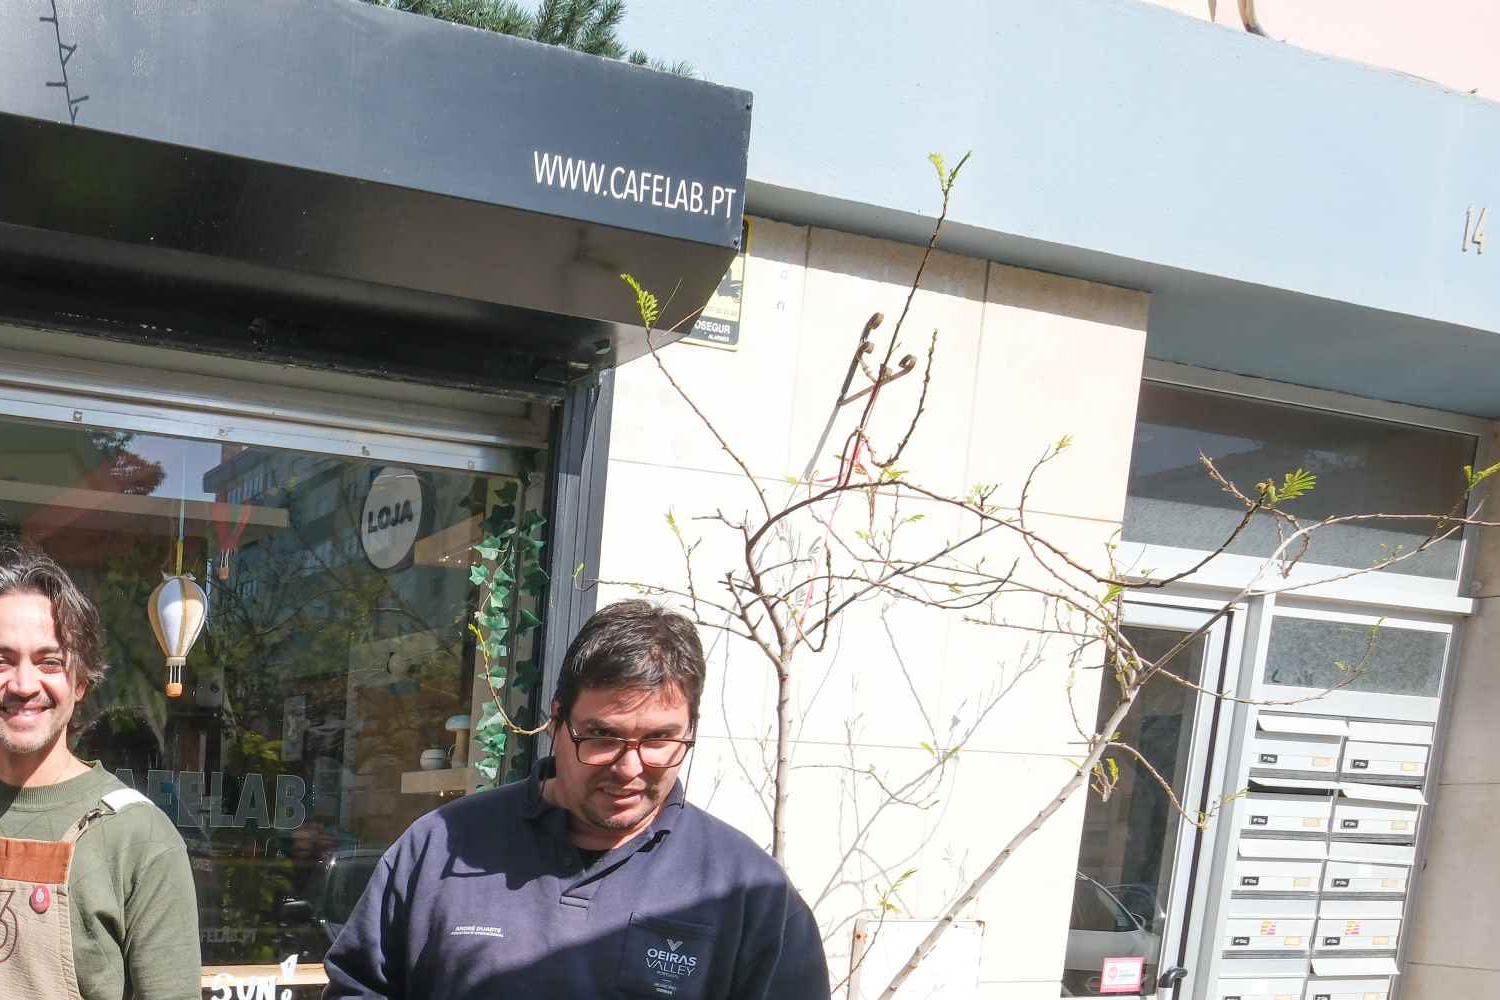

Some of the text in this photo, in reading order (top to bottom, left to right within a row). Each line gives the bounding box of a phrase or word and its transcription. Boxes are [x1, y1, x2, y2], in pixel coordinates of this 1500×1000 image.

[534, 151, 736, 218] WWW.CAFELAB.PT
[1461, 203, 1490, 255] 14
[694, 319, 730, 334] OSEGUR
[367, 499, 414, 533] LOJA
[113, 768, 306, 829] FELAB
[476, 926, 502, 934] DUARTE
[646, 957, 695, 977] VALLEY
[647, 948, 697, 967] OEIRAS
